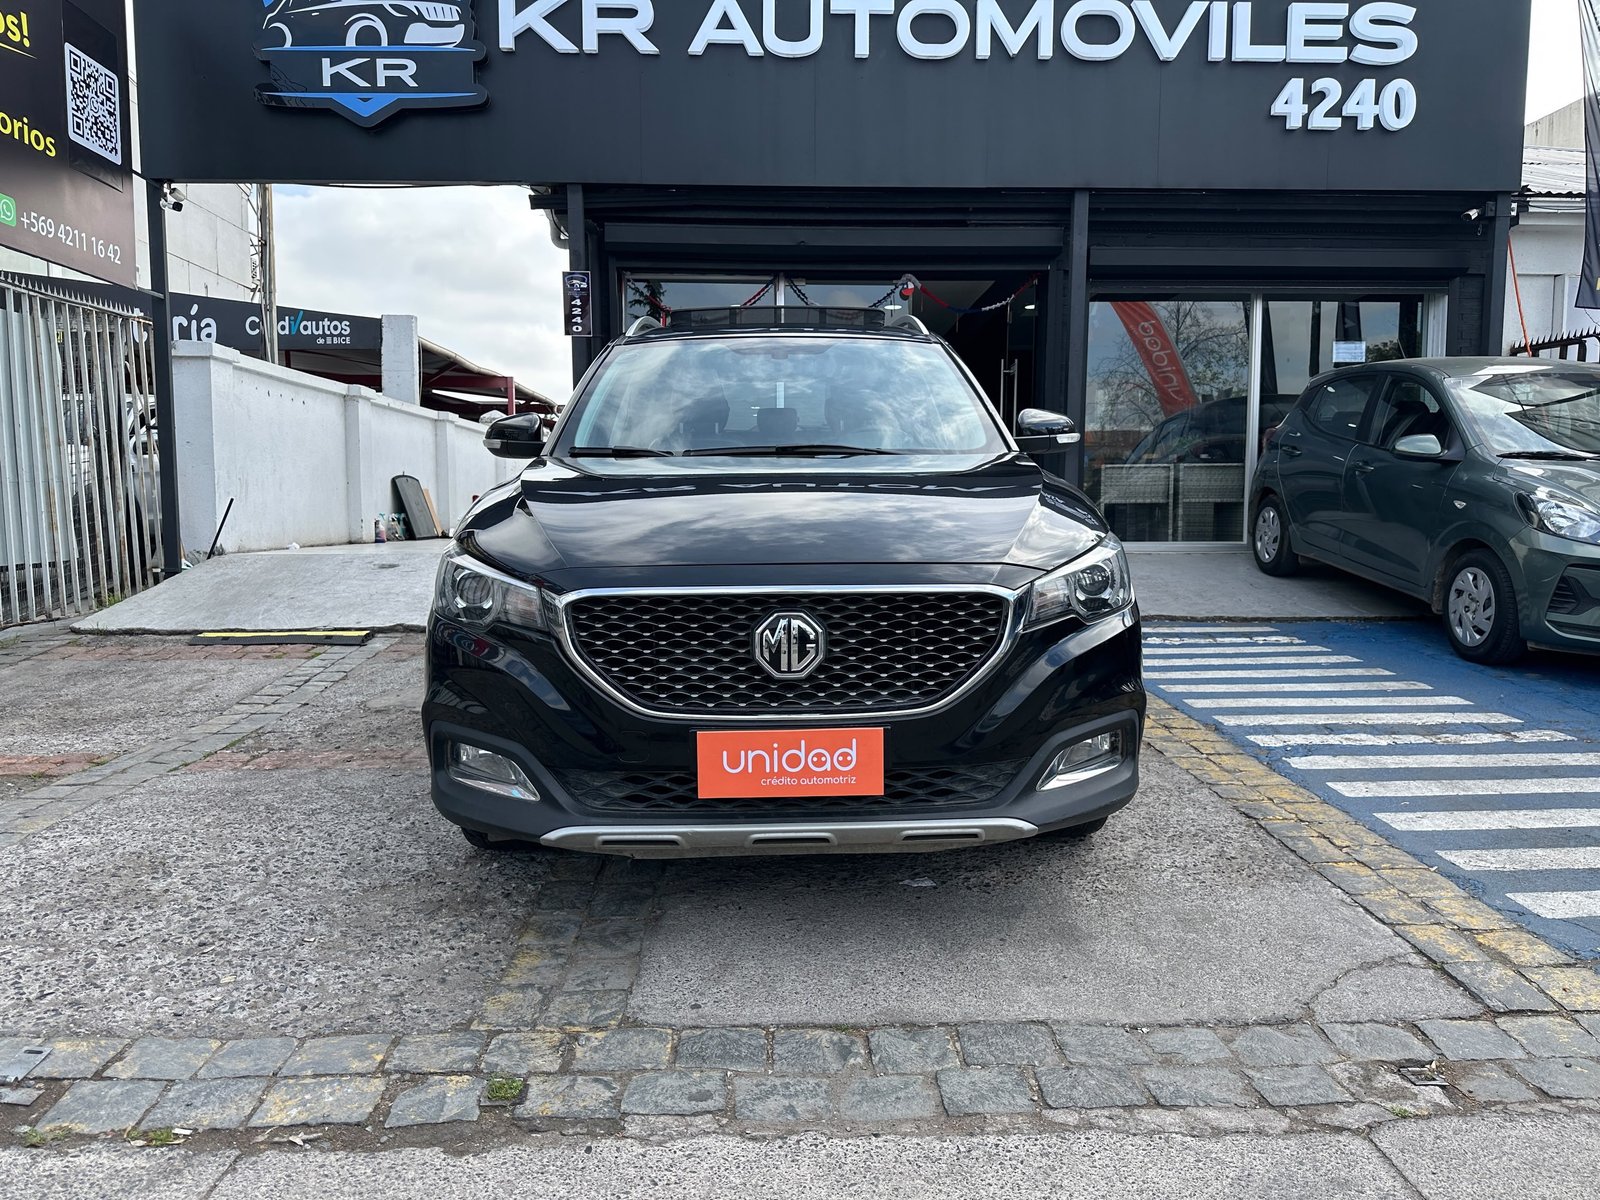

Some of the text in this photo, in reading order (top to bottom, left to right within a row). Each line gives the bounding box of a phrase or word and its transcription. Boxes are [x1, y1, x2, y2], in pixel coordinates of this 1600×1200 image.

[0, 11, 30, 47] s!
[499, 0, 1418, 66] KR AUTOMOVILES
[321, 57, 419, 88] KR
[1270, 78, 1417, 131] 4240
[20, 211, 122, 265] +569 4211 16 42
[571, 299, 583, 332] 4240
[316, 336, 350, 344] de BICE
[762, 618, 816, 671] MG
[722, 738, 857, 774] unidad
[760, 775, 857, 786] crédito automotriz
